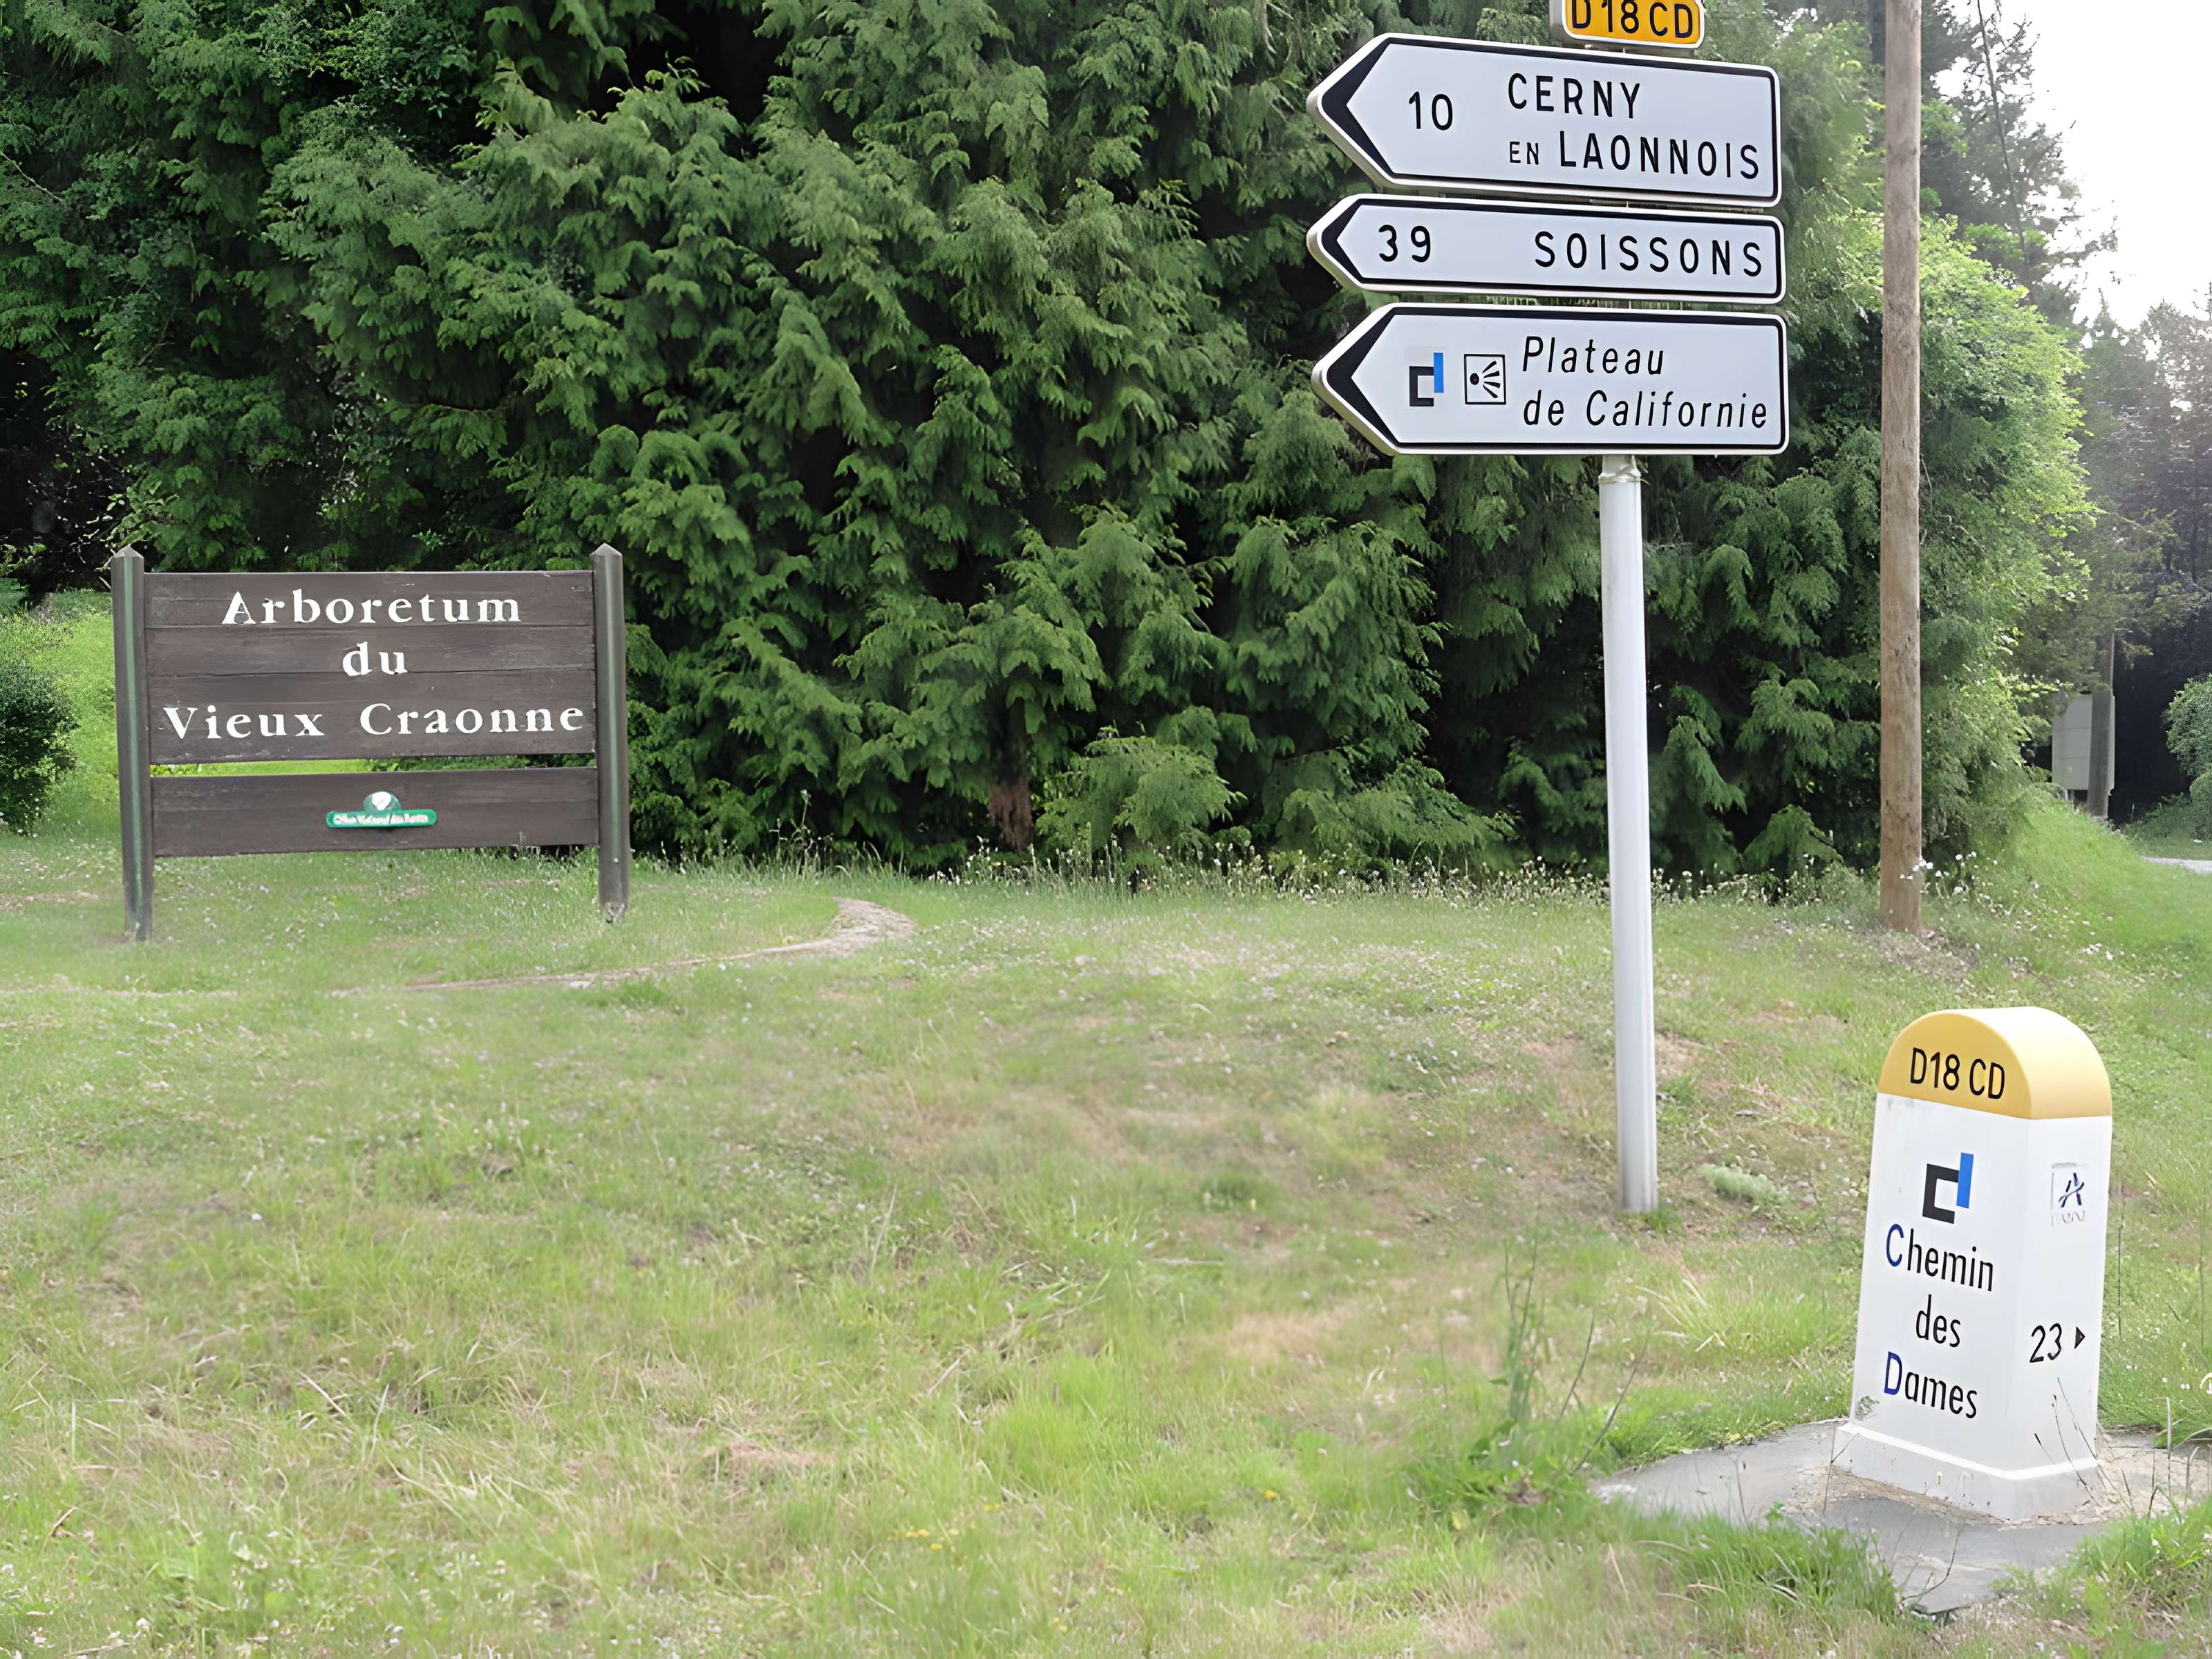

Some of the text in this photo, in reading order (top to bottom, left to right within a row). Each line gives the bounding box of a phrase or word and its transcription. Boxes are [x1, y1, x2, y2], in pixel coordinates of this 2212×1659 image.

[1408, 91, 1453, 131] 10
[1508, 73, 1641, 119] CERNY
[1509, 130, 1759, 180] EN LAONNOIS
[1378, 224, 1762, 277] 39 SOISSONS
[1522, 336, 1664, 375] Plateau
[1523, 390, 1767, 429] de Californie
[222, 588, 522, 624] Arboretum
[342, 641, 408, 677] du
[163, 703, 583, 739] Vieux Craonne
[1910, 1047, 2005, 1100] D18 CD
[1886, 1224, 1994, 1292] Chemin
[1915, 1293, 1961, 1348] des
[2029, 1322, 2063, 1363] 23
[1884, 1351, 1978, 1419] Dames
